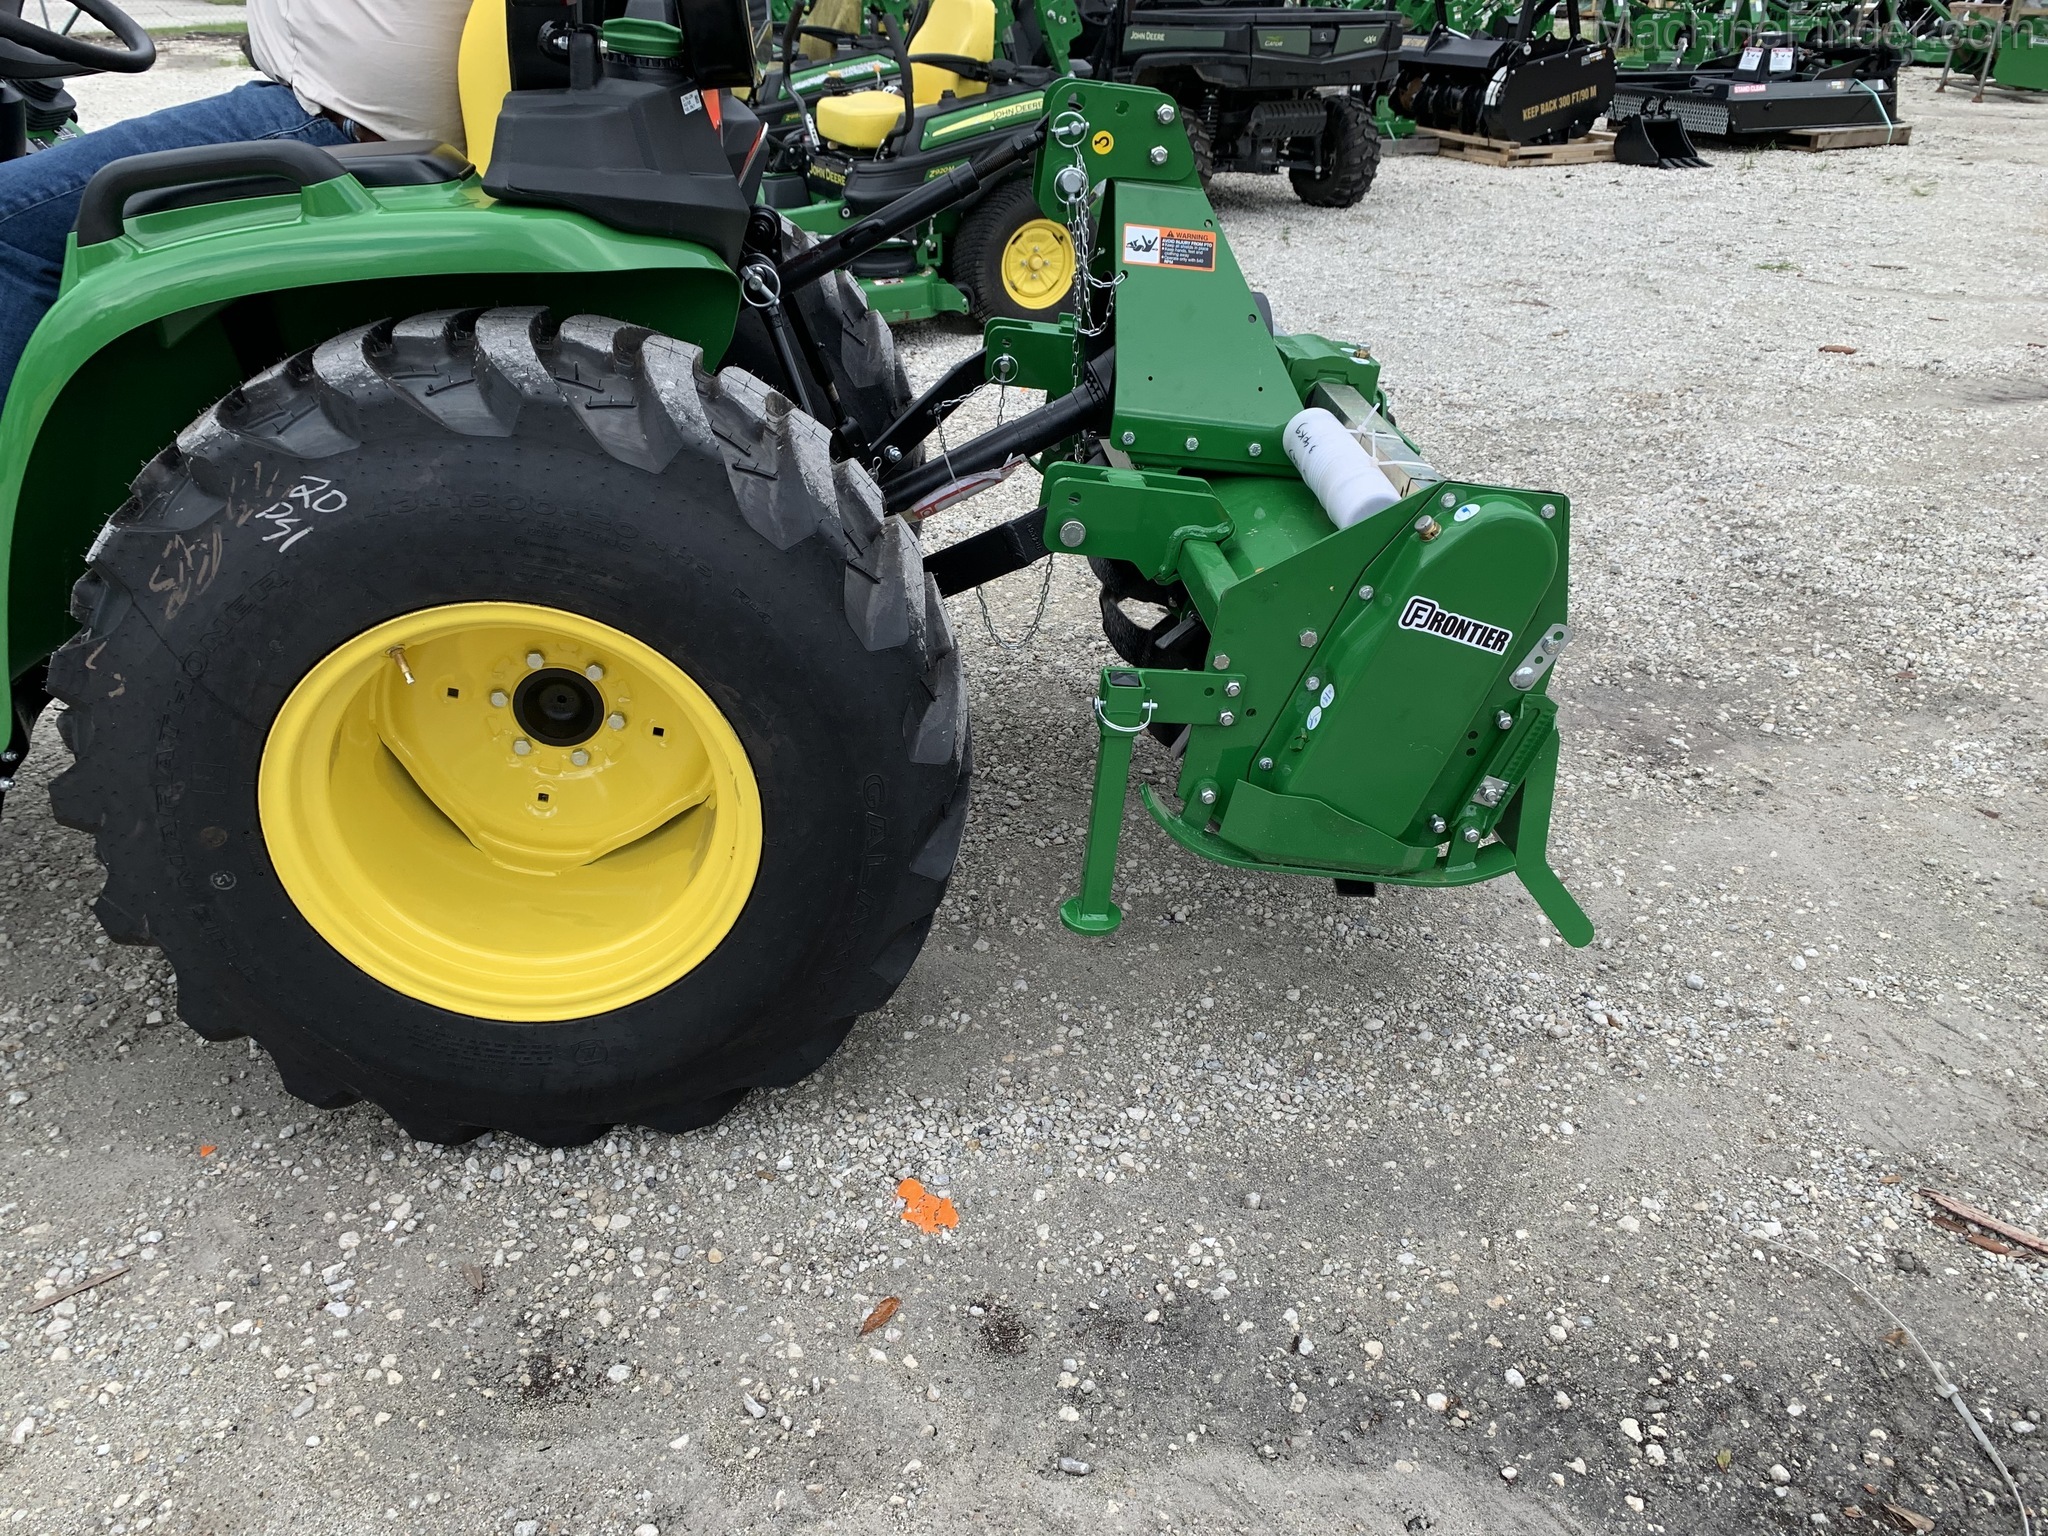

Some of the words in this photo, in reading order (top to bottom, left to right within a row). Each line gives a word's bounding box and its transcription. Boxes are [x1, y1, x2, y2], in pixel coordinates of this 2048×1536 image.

[1130, 31, 1145, 40] JOHN
[1146, 31, 1165, 41] DEERE
[992, 107, 1014, 121] JOHN
[1014, 100, 1043, 113] DEERE
[1522, 105, 1539, 120] KEEP
[1540, 99, 1557, 115] BACK
[1558, 94, 1570, 108] 300
[1590, 84, 1597, 97] M
[809, 161, 825, 178] JOHN
[825, 168, 846, 186] DEERE
[1176, 232, 1208, 240] WARNING
[1401, 598, 1510, 652] FRONTIER
